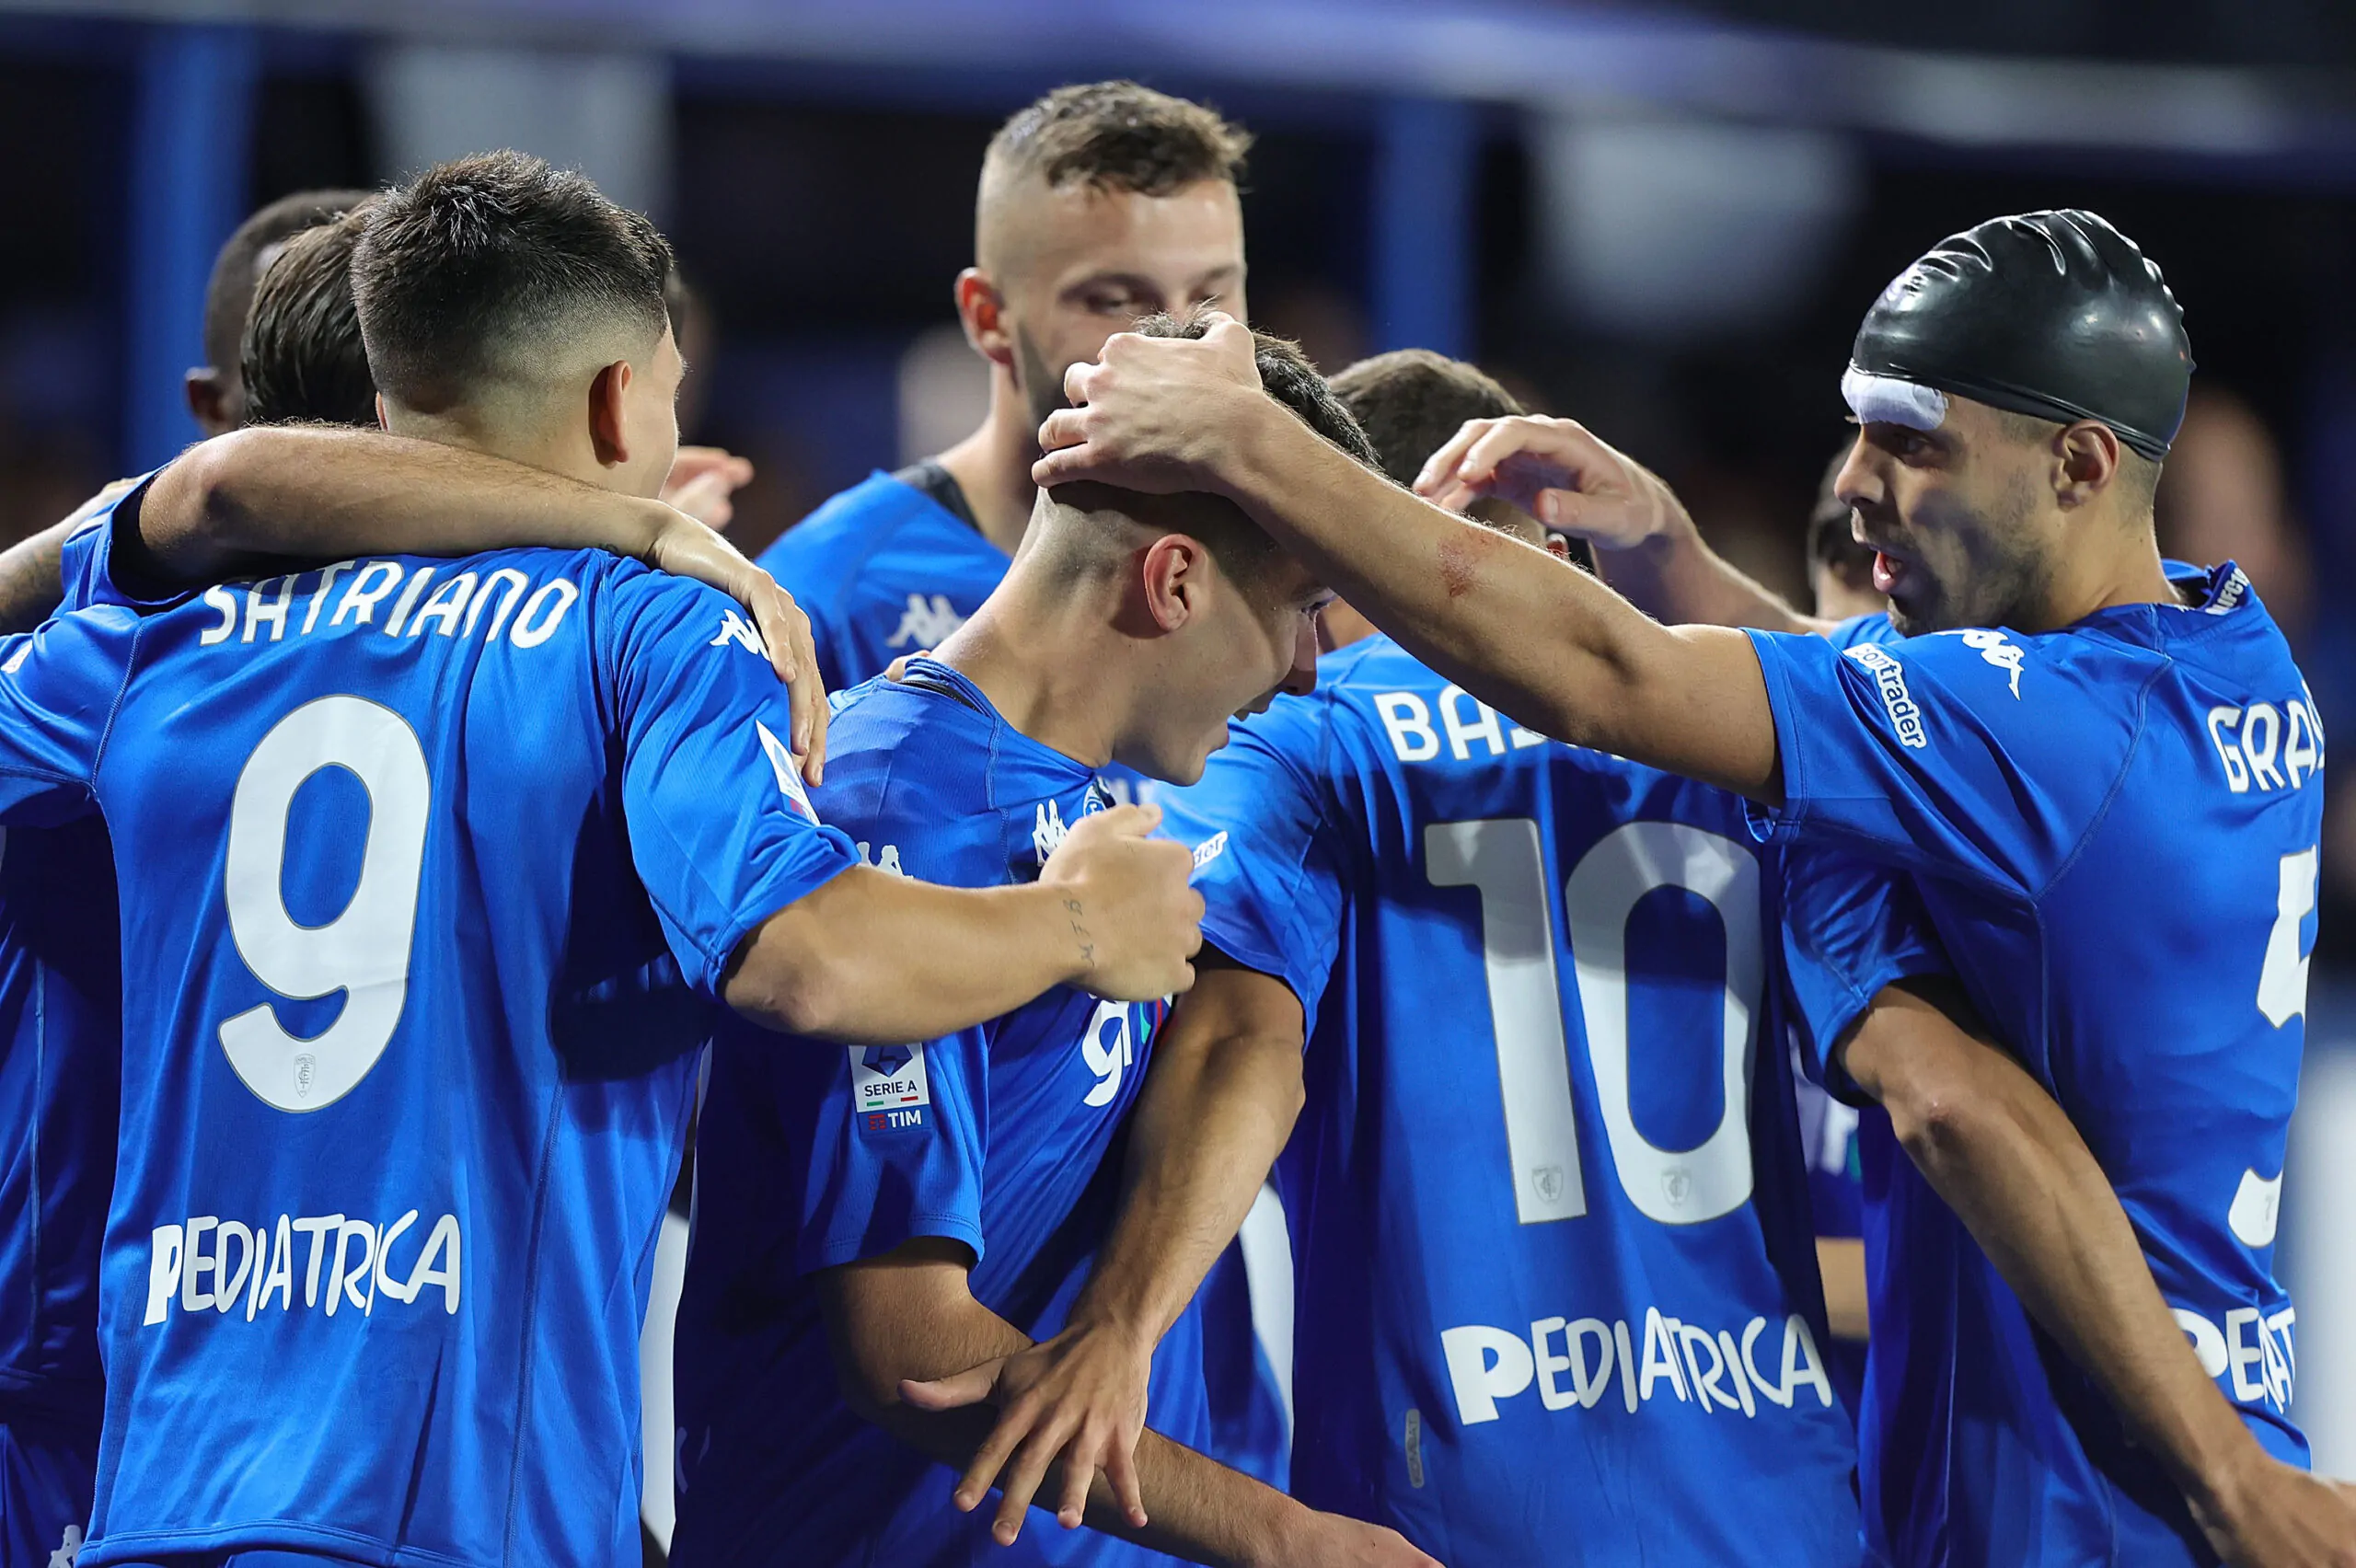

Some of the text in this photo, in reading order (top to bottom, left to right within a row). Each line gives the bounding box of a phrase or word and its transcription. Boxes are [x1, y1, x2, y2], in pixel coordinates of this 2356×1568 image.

[200, 560, 580, 649] SATRIANO
[217, 694, 431, 1113] 9
[1424, 817, 1763, 1225] 10
[864, 1079, 918, 1097] SERIE A
[887, 1109, 921, 1128] TIM
[143, 1209, 461, 1326] PEDIATRICA
[1440, 1305, 1832, 1426] PEDIATRICA
